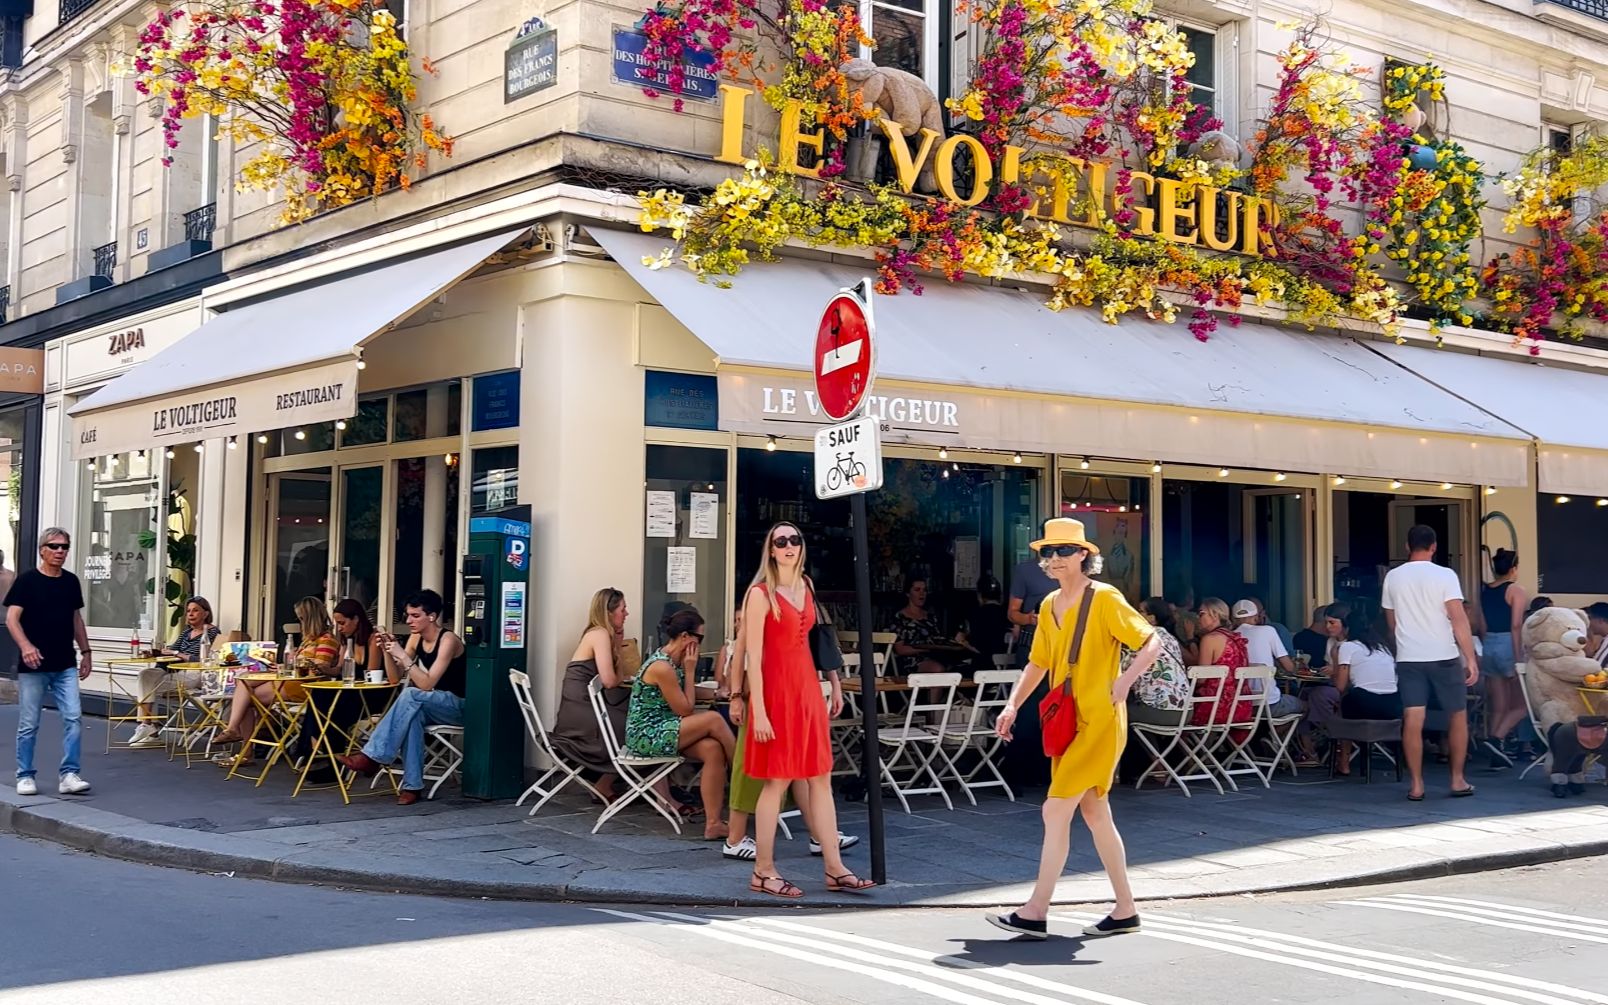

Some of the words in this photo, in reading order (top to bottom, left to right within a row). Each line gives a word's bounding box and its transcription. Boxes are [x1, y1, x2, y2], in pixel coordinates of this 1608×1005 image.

[523, 45, 540, 60] RUE
[616, 49, 635, 63] DES
[508, 66, 522, 80] DES
[524, 54, 553, 74] FRANCS
[712, 83, 826, 178] LE
[880, 118, 1281, 258] VOLTIGEUR
[109, 328, 145, 355] ZAPA
[0, 363, 38, 376] APA
[275, 383, 343, 410] RESTAURANT
[762, 387, 797, 414] LE
[803, 390, 960, 427] VTIGEUR
[154, 410, 167, 431] LE
[169, 397, 237, 428] VOLTIGEUR
[81, 426, 97, 444] CAFÉ
[829, 425, 860, 447] SAUF
